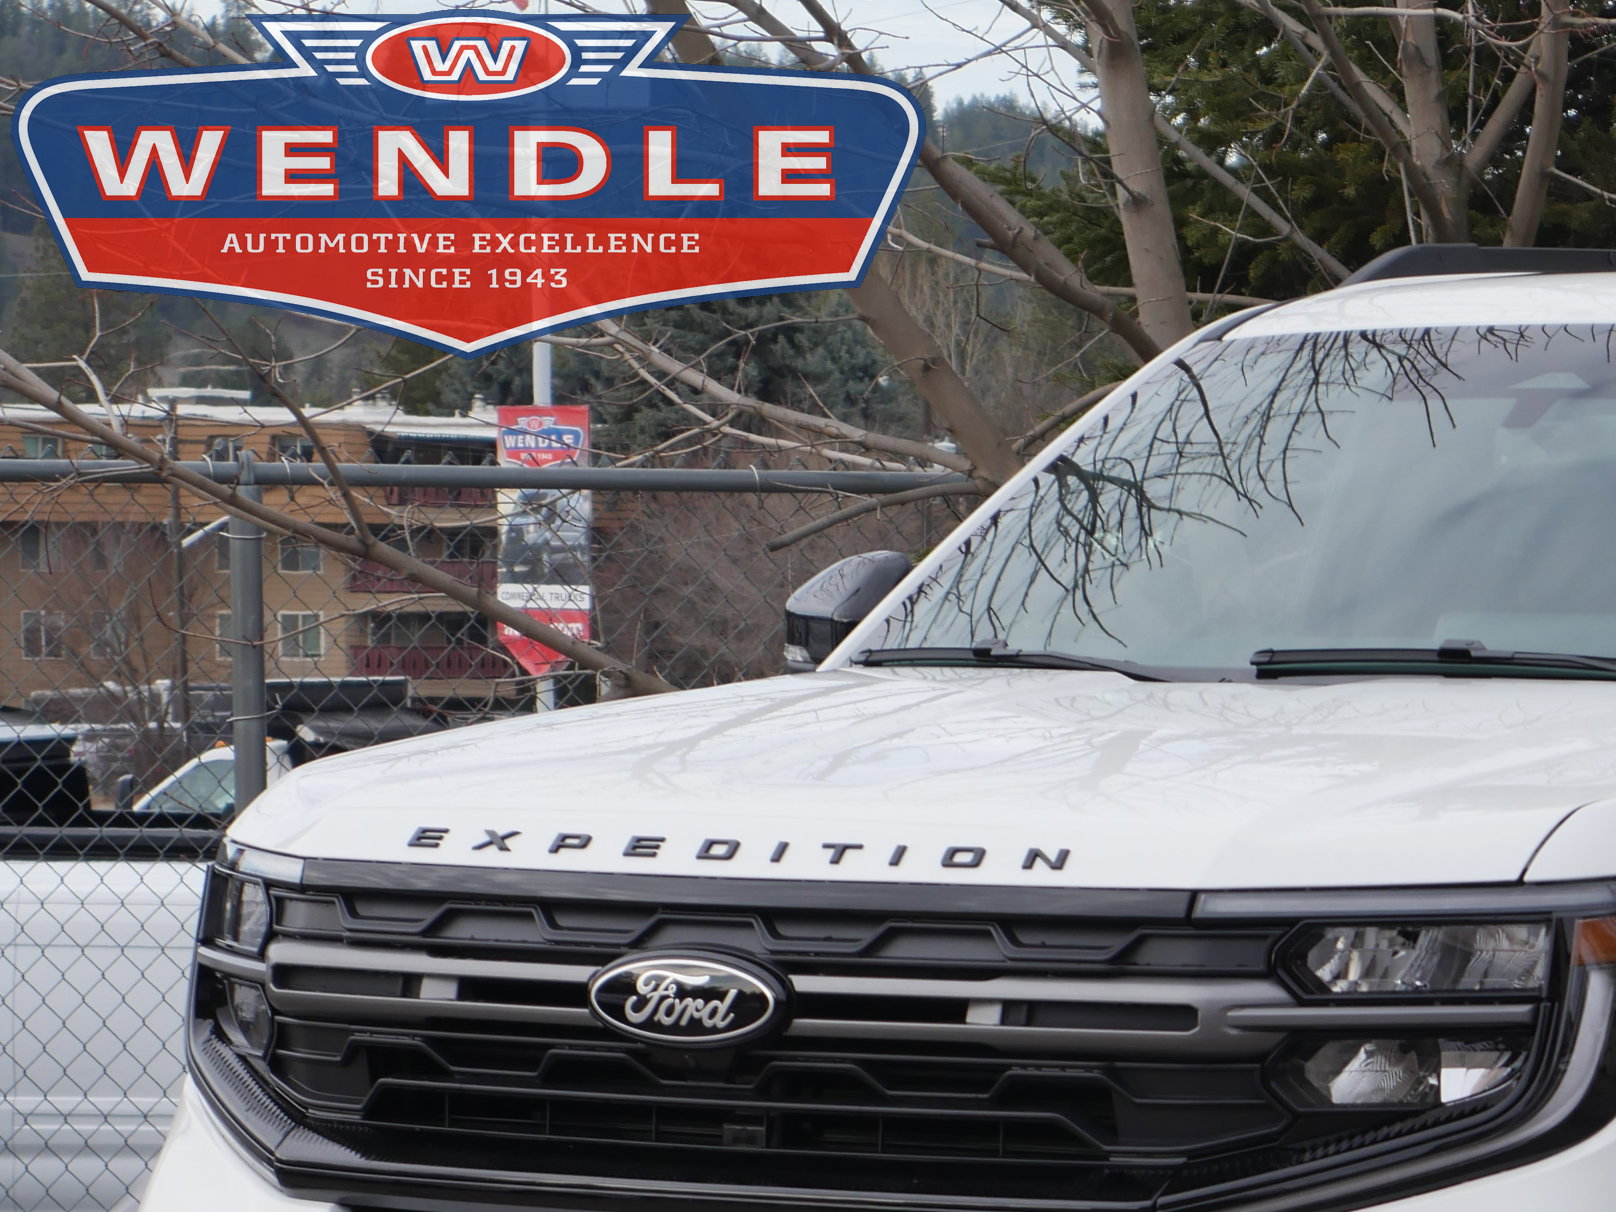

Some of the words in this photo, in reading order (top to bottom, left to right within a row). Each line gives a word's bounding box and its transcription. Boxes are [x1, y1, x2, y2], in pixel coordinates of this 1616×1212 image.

[504, 434, 575, 449] WENDLE
[549, 591, 585, 602] TRUKS
[407, 826, 1071, 871] EXPEDITION
[623, 969, 739, 1029] Ford
